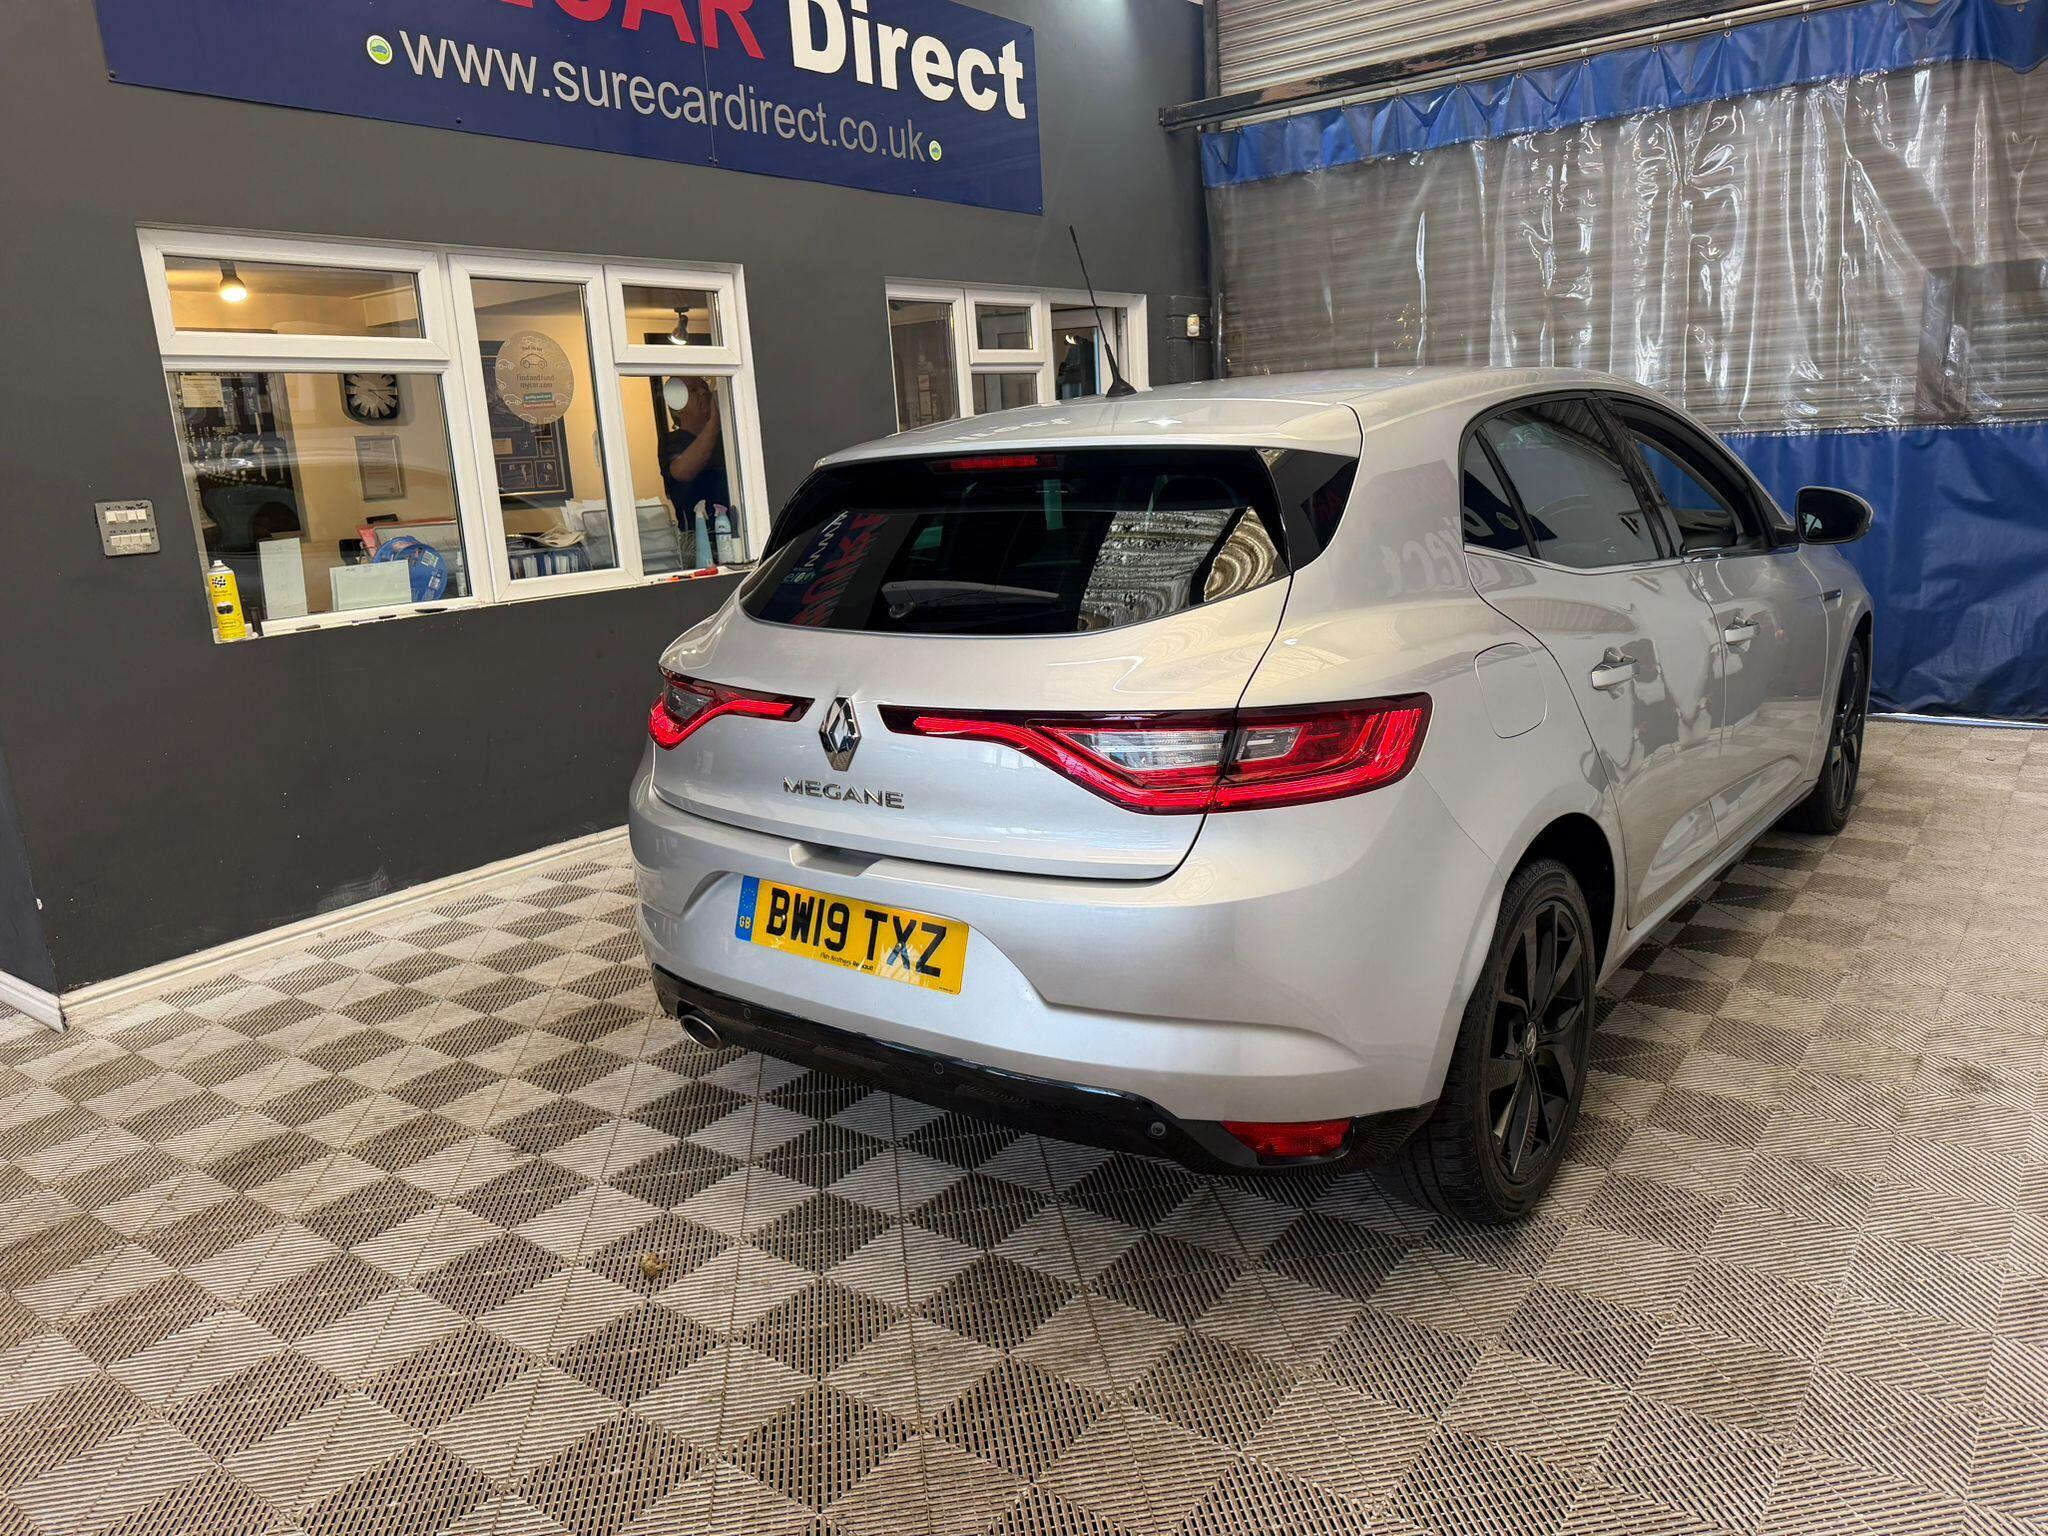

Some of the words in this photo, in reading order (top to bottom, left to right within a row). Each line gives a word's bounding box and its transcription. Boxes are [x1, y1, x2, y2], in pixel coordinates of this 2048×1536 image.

[399, 30, 926, 163] www.surecardirect.co.uk
[789, 0, 1027, 120] Direct
[783, 776, 905, 809] MEGANE
[738, 916, 751, 930] GB
[766, 887, 850, 952] BW19
[864, 908, 947, 978] TXZ
